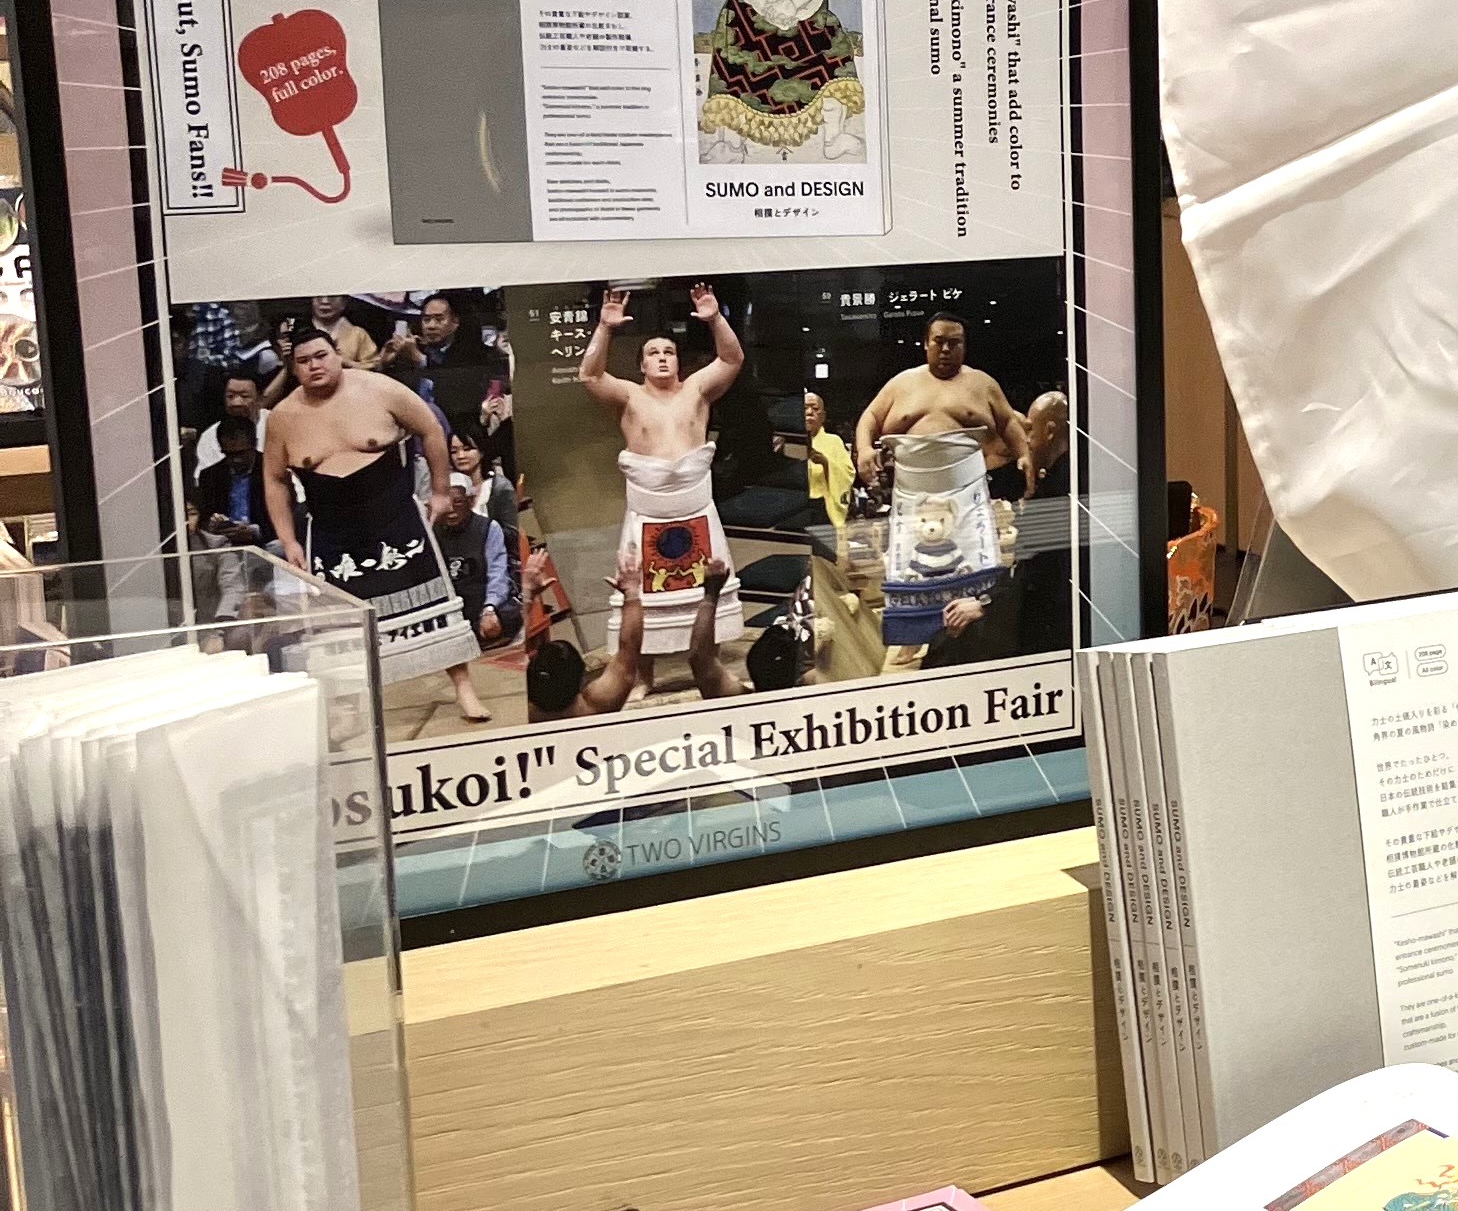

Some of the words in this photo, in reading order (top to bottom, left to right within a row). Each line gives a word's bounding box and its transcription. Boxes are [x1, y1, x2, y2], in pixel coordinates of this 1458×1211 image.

[181, 43, 203, 116] Sumo
[259, 62, 288, 84] 208
[290, 45, 337, 76] pages,
[929, 27, 941, 75] sumo
[952, 73, 962, 83] a
[1008, 51, 1021, 85] that
[271, 80, 299, 102] full
[300, 66, 344, 89] color.
[987, 47, 1001, 144] ceremonies
[1008, 89, 1022, 121] add
[953, 87, 964, 158] summer
[1009, 125, 1023, 169] color
[187, 123, 214, 199] Fans!!
[705, 181, 759, 198] SUMO
[764, 181, 795, 197] and
[801, 181, 864, 197] DESIGN
[1010, 173, 1022, 191] to
[955, 161, 969, 238] tradition
[575, 725, 737, 795] Special
[750, 700, 971, 760] Exhibition
[984, 682, 1064, 725] Fair
[625, 838, 682, 866] TWO
[688, 821, 782, 856] VIRGINS
[1095, 799, 1105, 840] SUMO
[1104, 872, 1115, 923] DESIGN
[1119, 799, 1129, 840] SUMO
[1127, 872, 1139, 923] DESIGN
[1133, 800, 1144, 841] SUMO
[1142, 874, 1153, 925] DESIGN
[1152, 803, 1163, 845] SUMO
[1161, 878, 1173, 930] DESIGN
[1171, 800, 1181, 842] SUMO
[1179, 875, 1190, 928] DESIGN
[1436, 969, 1454, 978] sumo
